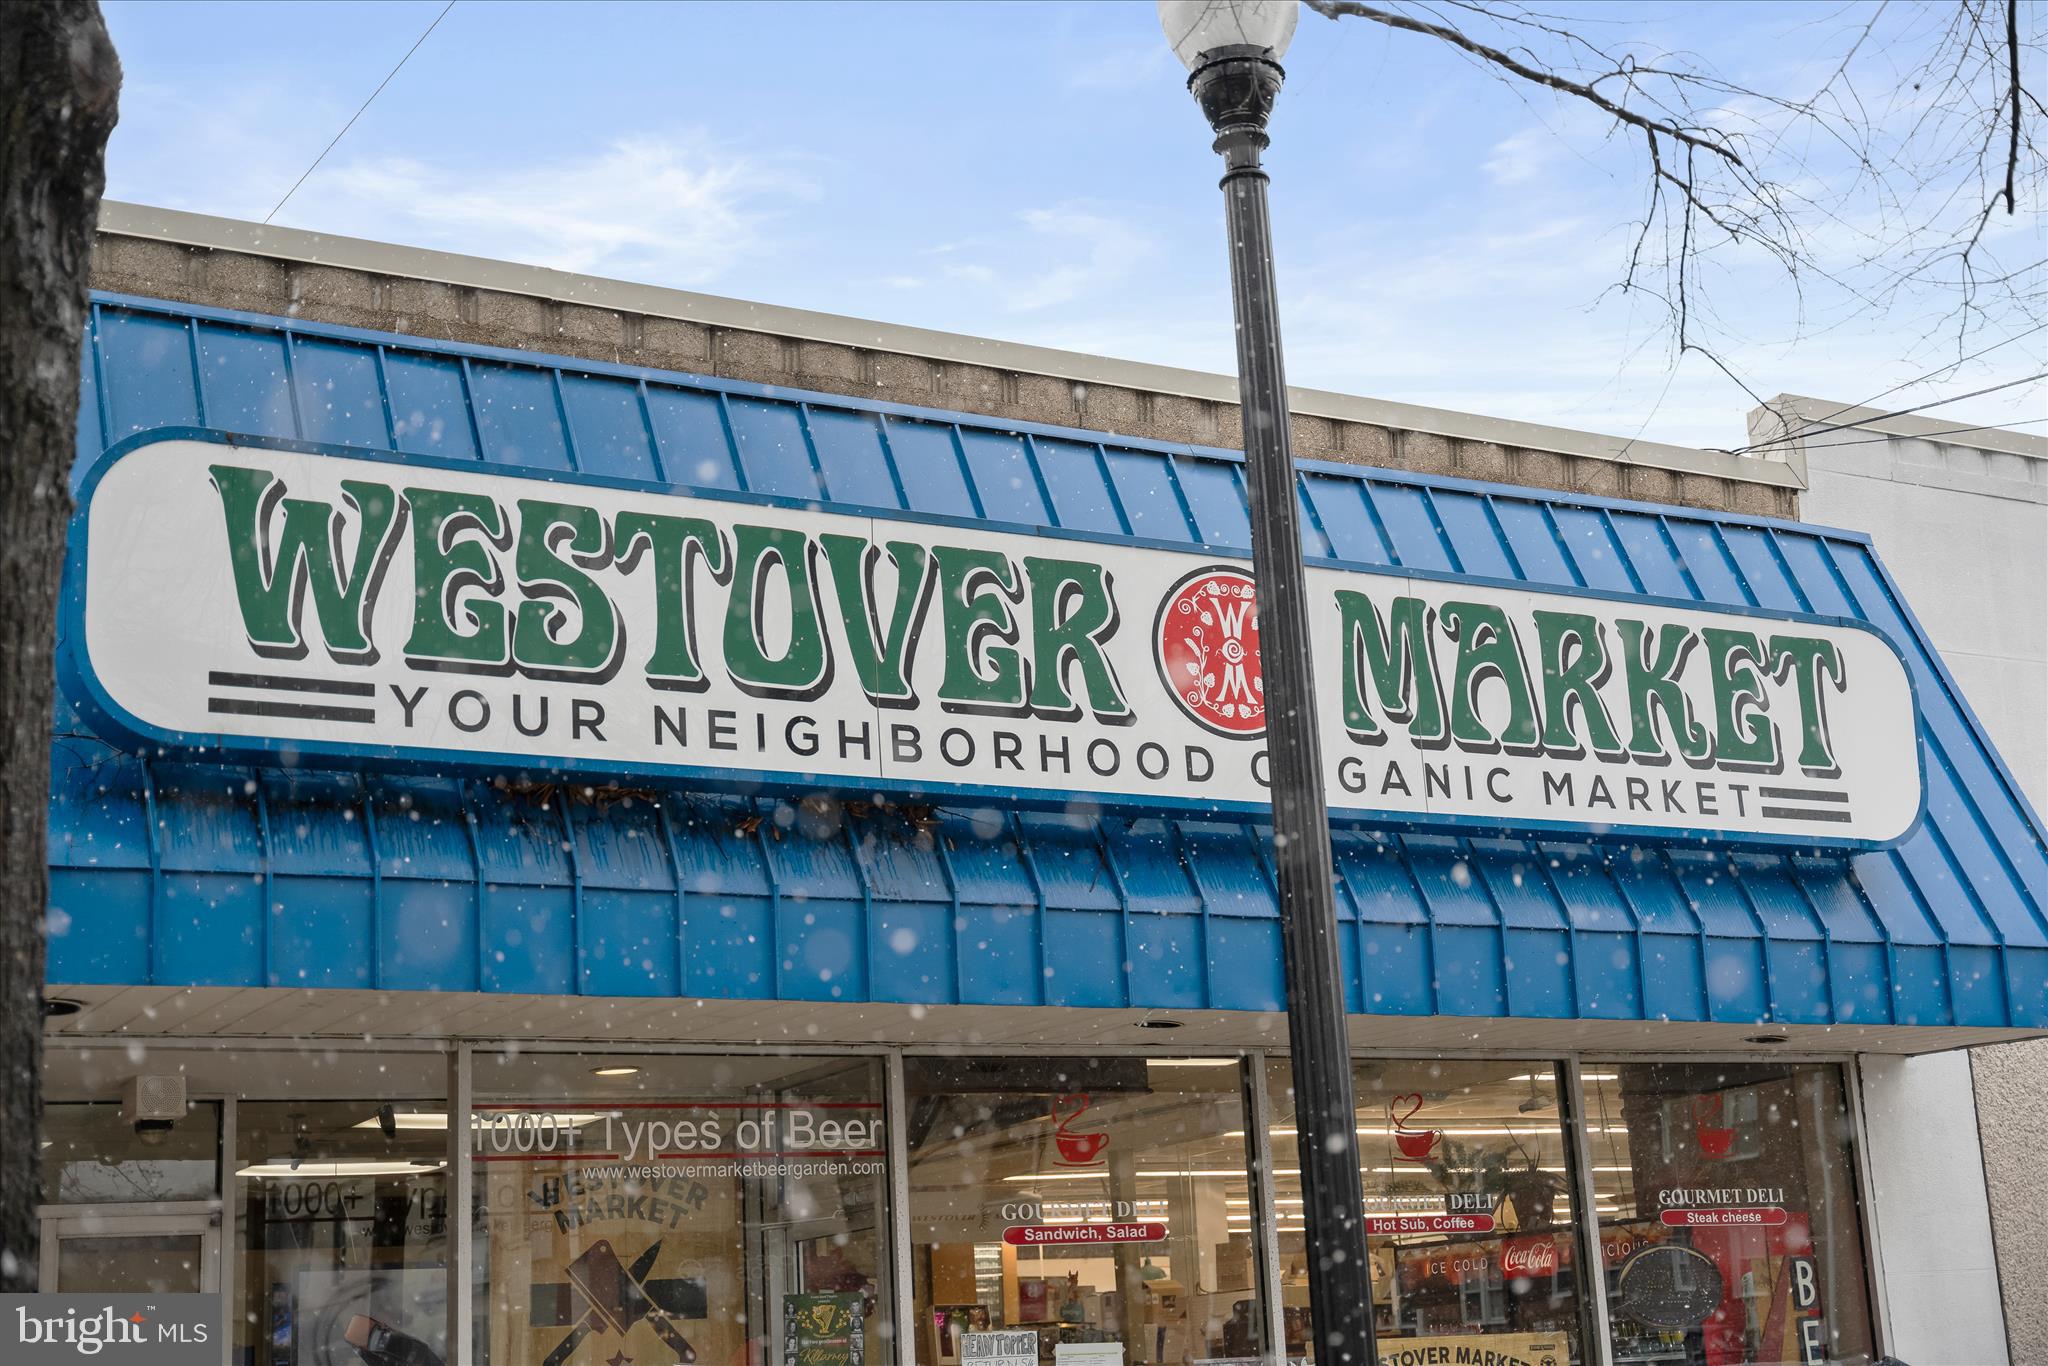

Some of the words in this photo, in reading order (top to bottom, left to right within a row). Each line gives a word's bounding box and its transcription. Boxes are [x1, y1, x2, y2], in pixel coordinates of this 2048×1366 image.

[209, 464, 1136, 726] WESTOVER
[1334, 589, 1848, 779] MARKET
[391, 685, 607, 741] YOUR
[654, 704, 1214, 783] NEIGHBORHOOD
[1250, 750, 1513, 803] OGANIC
[1544, 770, 1750, 818] MARKET
[474, 1112, 582, 1152] 1000+
[594, 1112, 722, 1161] Types
[736, 1110, 776, 1150] of
[789, 1110, 883, 1149] Beer
[582, 1160, 885, 1180] www.westovermarketbeergarden.com
[1450, 1193, 1494, 1210] DELI
[1658, 1188, 1743, 1205] GOURMET
[1747, 1188, 1785, 1204] DELI
[554, 1194, 689, 1235] MARKET
[1373, 1218, 1397, 1231] Hot
[1400, 1218, 1430, 1232] Sub,
[1433, 1217, 1475, 1230] Coffee
[1687, 1211, 1718, 1224] Steak
[1721, 1211, 1762, 1223] cheese
[1024, 1227, 1102, 1242] Sandwich,
[1106, 1225, 1147, 1239] Salad
[1426, 1260, 1447, 1276] ICE
[1453, 1257, 1489, 1273] COLD
[996, 1333, 1036, 1355] TOPPER
